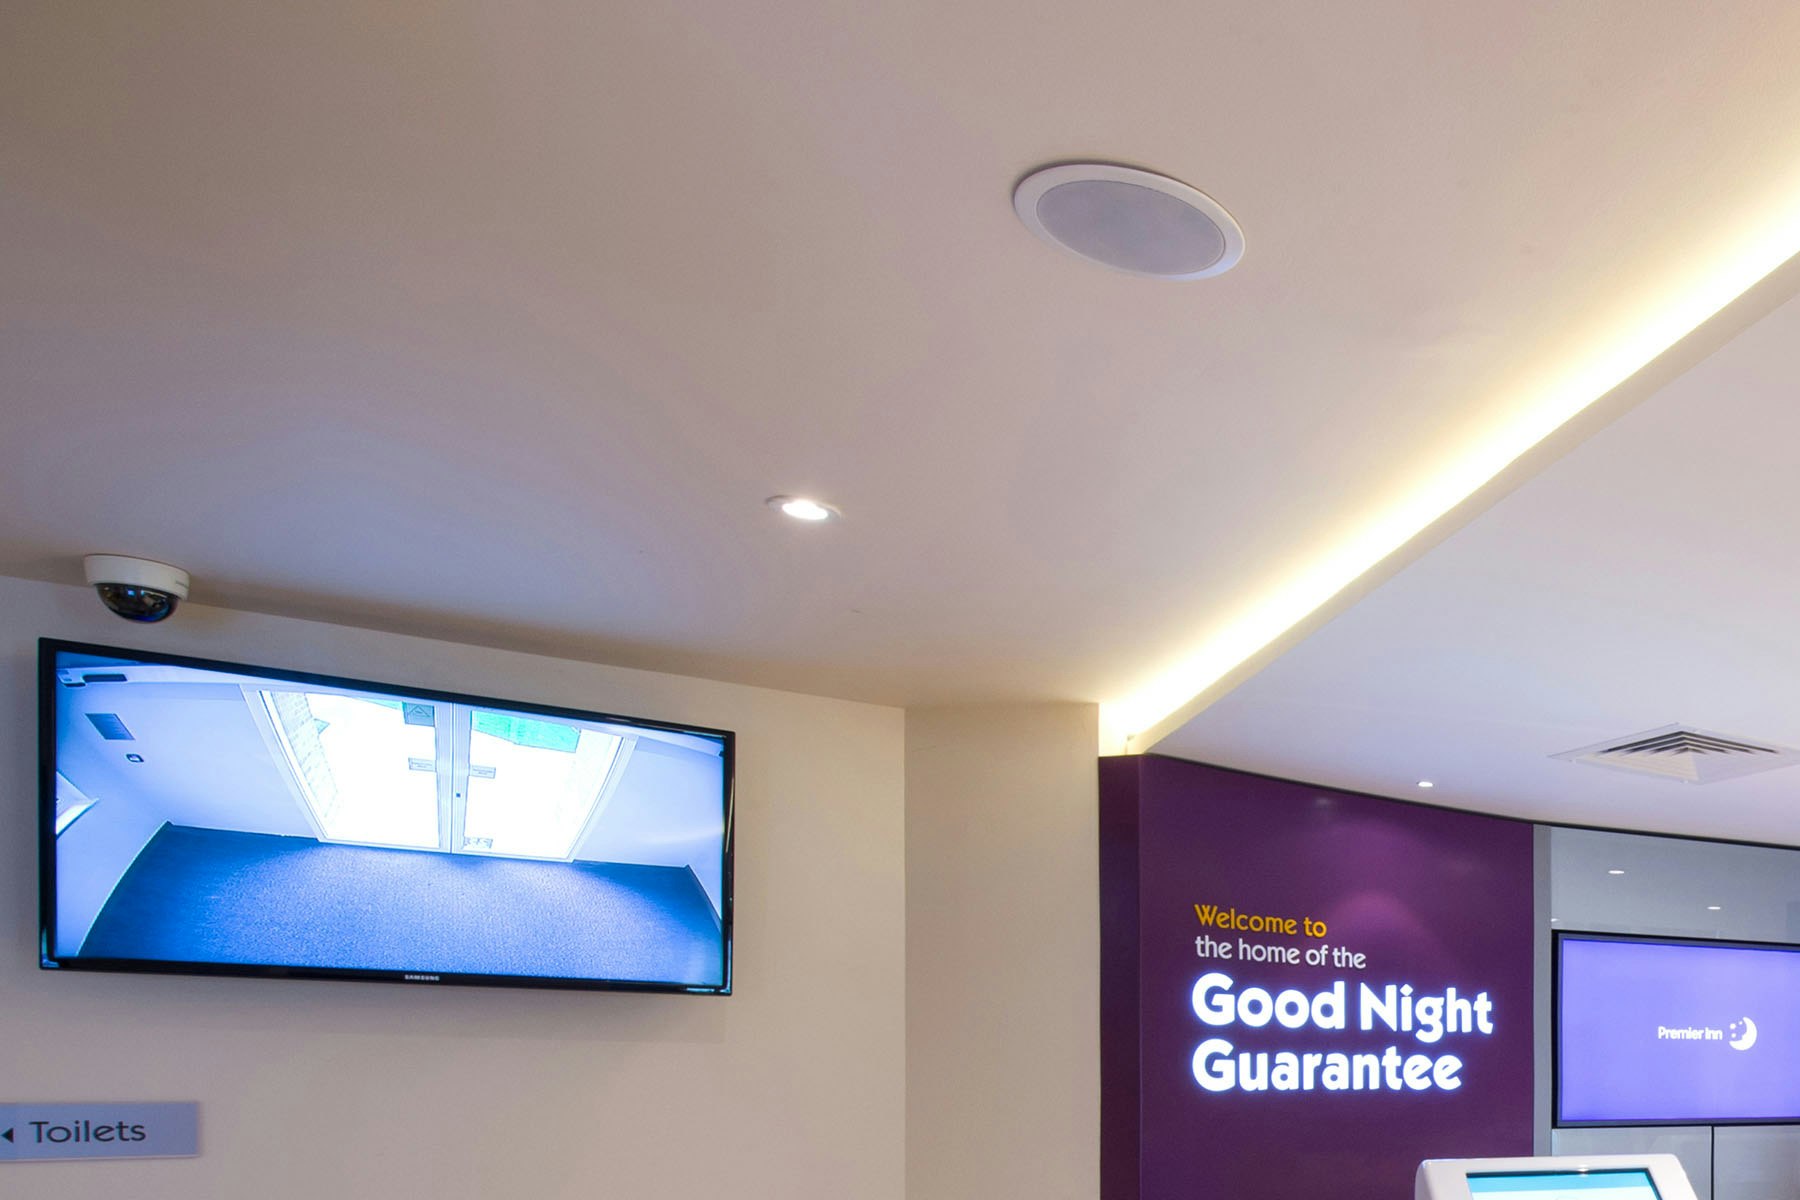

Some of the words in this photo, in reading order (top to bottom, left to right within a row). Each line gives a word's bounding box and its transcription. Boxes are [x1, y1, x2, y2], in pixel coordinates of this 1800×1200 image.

[1195, 904, 1297, 935] Welcome
[1303, 916, 1327, 937] to
[1195, 935, 1233, 959] the
[1238, 938, 1300, 964] home
[1305, 945, 1329, 966] of
[1332, 946, 1366, 969] the
[1191, 972, 1346, 1029] Good
[1360, 982, 1494, 1043] Night
[1657, 1026, 1704, 1040] Premier
[1191, 1038, 1464, 1092] Guarantee
[28, 1120, 146, 1143] Toilets
